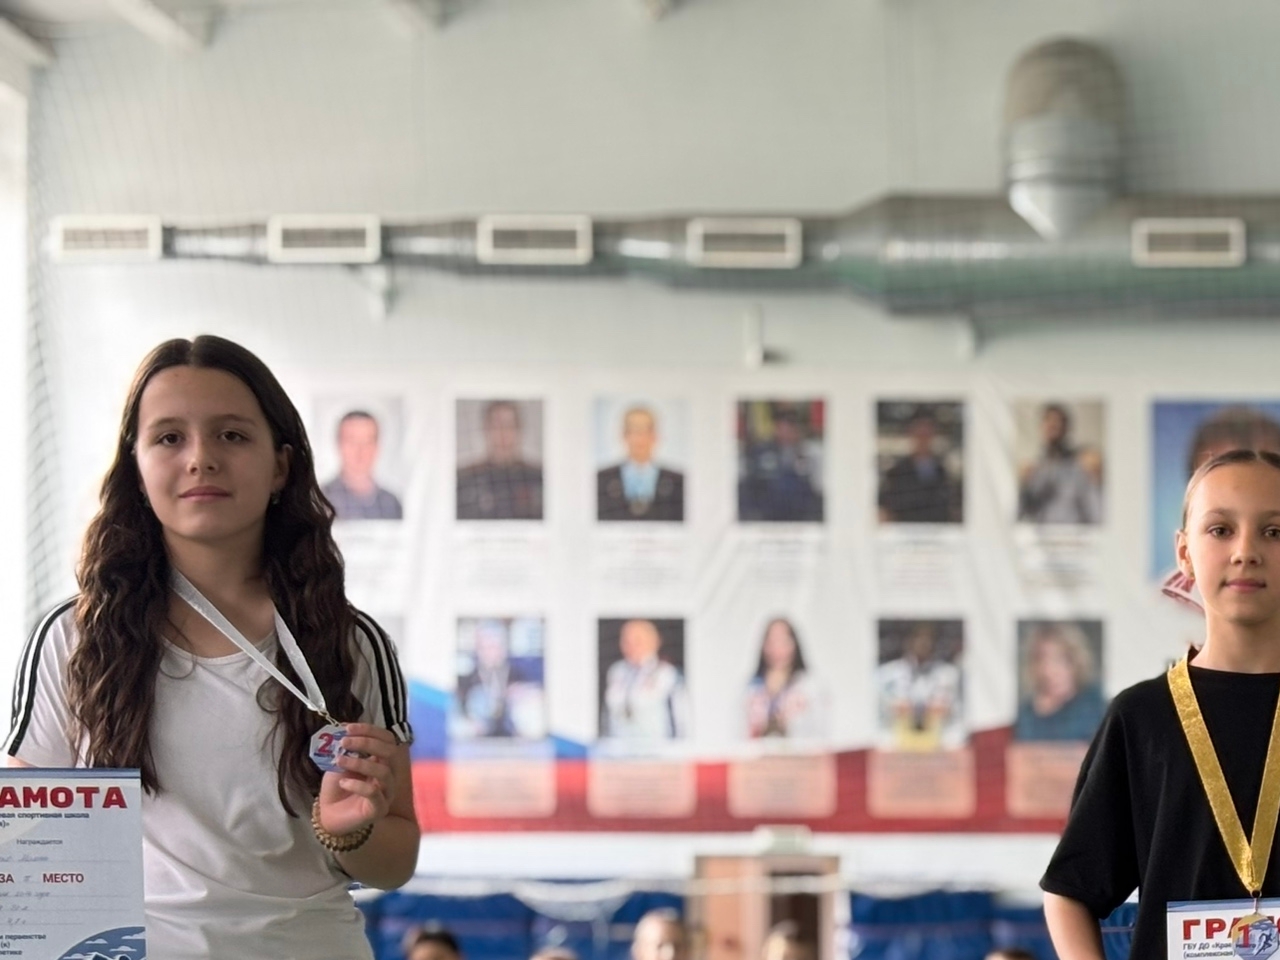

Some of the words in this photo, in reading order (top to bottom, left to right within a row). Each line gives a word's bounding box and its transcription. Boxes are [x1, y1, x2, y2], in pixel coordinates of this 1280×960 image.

[318, 732, 334, 754] 2
[42, 873, 85, 884] МЕСТО
[1238, 923, 1250, 948] 1
[1183, 943, 1197, 951] ГБУ
[1198, 942, 1210, 950] ДО
